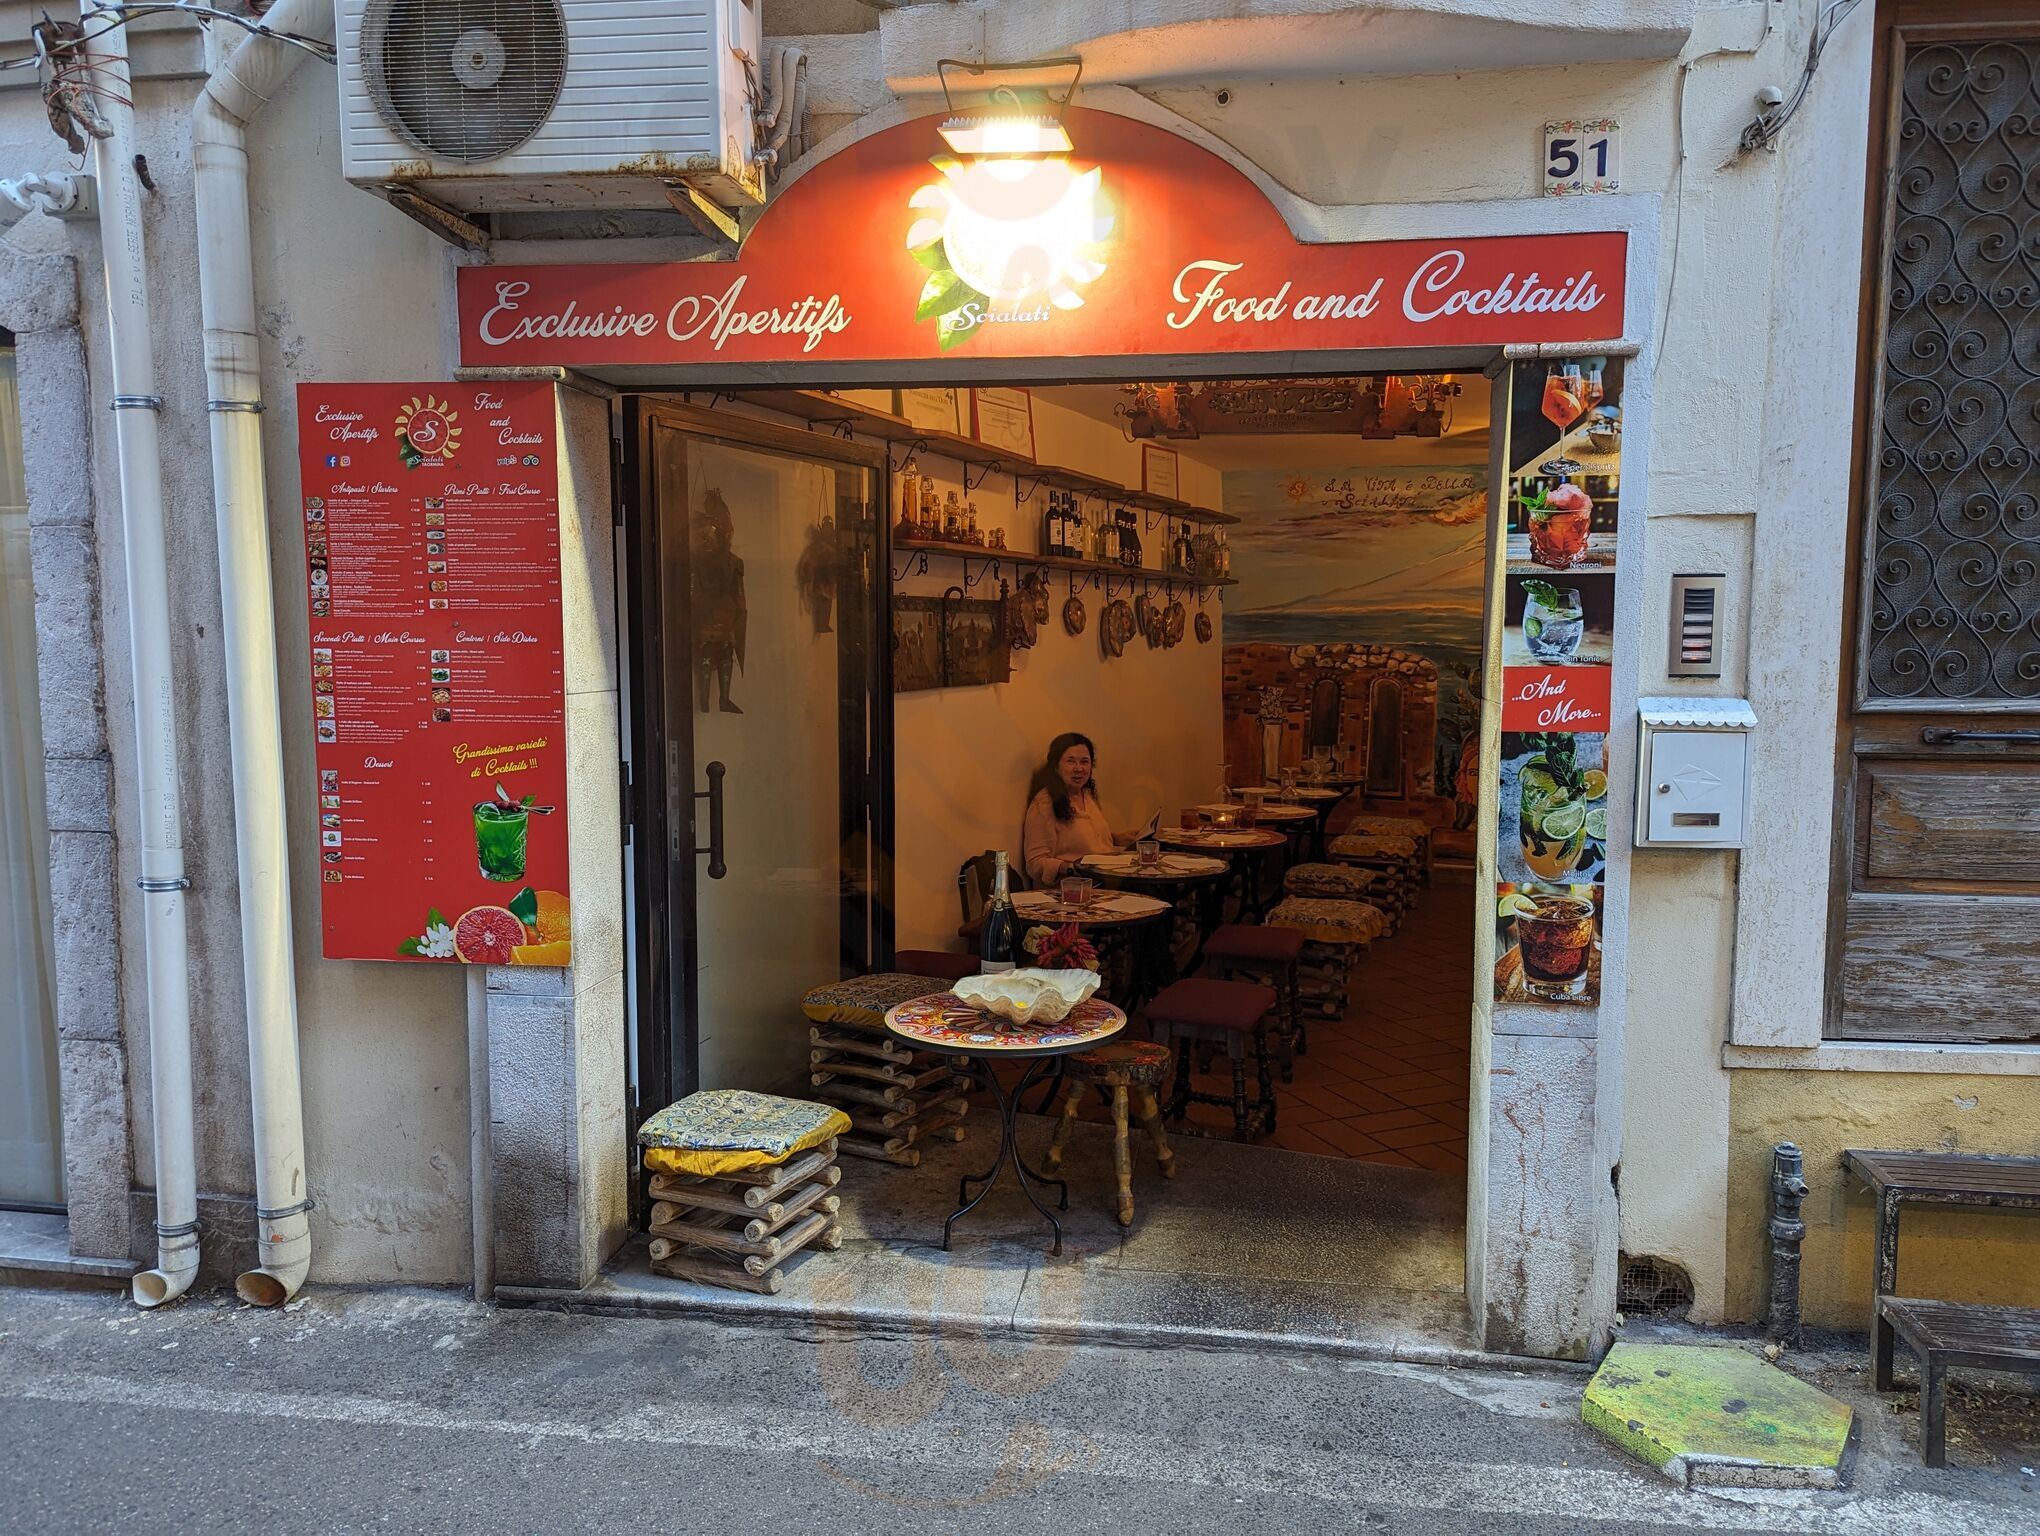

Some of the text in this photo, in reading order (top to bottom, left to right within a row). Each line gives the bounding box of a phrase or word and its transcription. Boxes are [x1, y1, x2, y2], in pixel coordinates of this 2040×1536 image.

[1547, 138, 1608, 178] 51
[1166, 249, 1606, 329] Food and Cocktails
[479, 275, 853, 353] Exclusive Aperitifs
[946, 302, 1051, 331] Scialati
[474, 392, 504, 411] Food
[315, 404, 364, 422] Exclusive
[489, 415, 511, 427] and
[330, 422, 379, 443] Aperitifs
[413, 420, 439, 442] S
[498, 427, 544, 445] Cocktails
[331, 482, 365, 495] Antipasti
[371, 482, 399, 494] Starters
[444, 483, 466, 495] Primi
[466, 483, 489, 495] Piatti
[498, 483, 518, 495] First
[517, 483, 541, 495] Course
[1569, 560, 1602, 571] Negroni
[313, 631, 341, 643] Secondi
[342, 631, 365, 644] Piatti
[374, 632, 399, 644] Main
[399, 631, 426, 644] Courses
[455, 631, 484, 643] Contorni
[493, 631, 511, 643] Side
[512, 632, 538, 644] Dishes
[1580, 655, 1601, 663] Tonic
[1537, 698, 1602, 727] More...
[363, 756, 394, 769] Dessert
[452, 743, 515, 764] Grandissima
[470, 765, 481, 778] di
[485, 758, 529, 777] Cocktails
[1562, 869, 1589, 878] Mojito
[1550, 992, 1592, 1002] Cuba Libre
